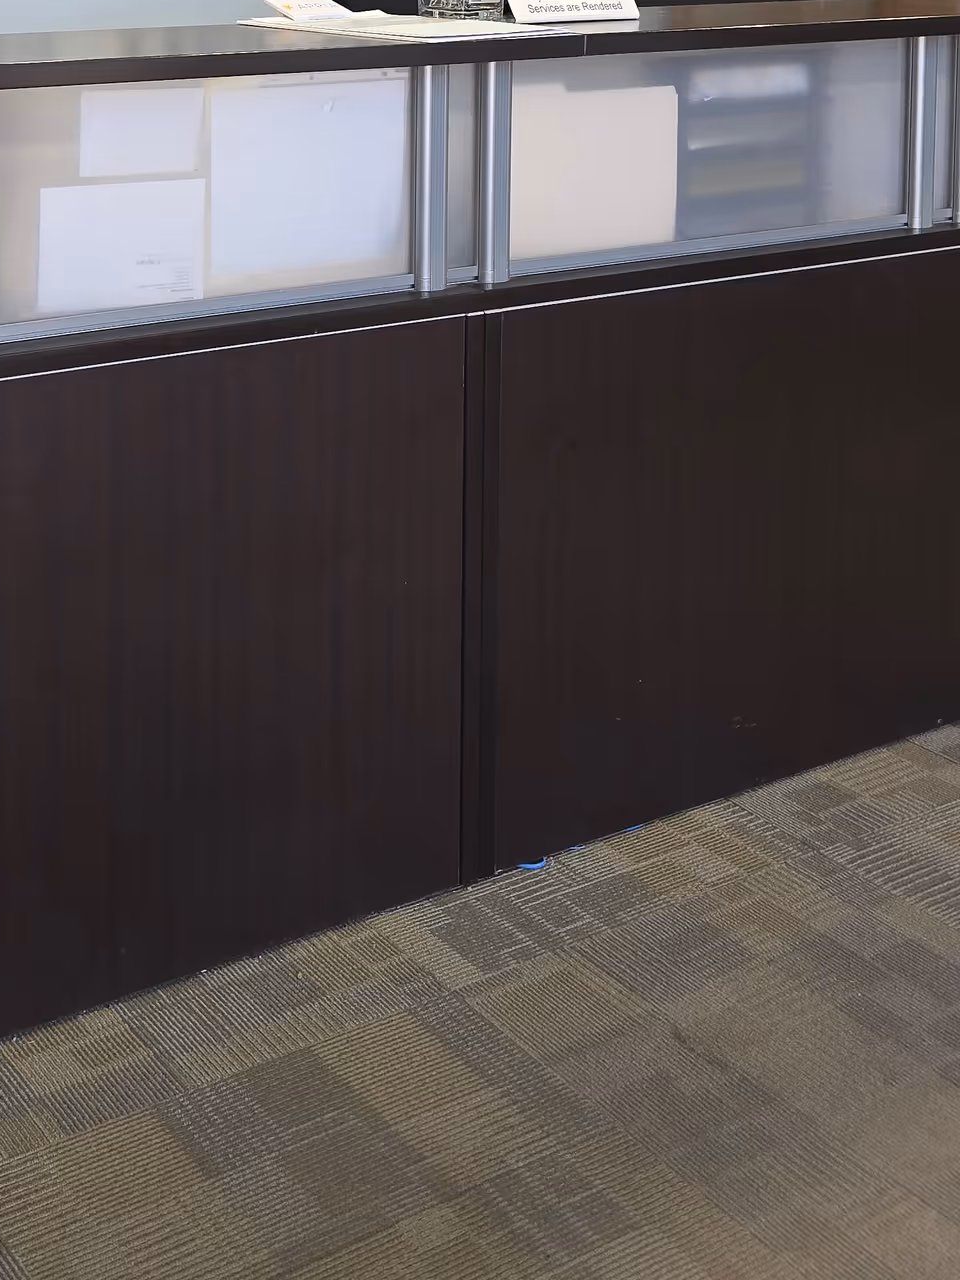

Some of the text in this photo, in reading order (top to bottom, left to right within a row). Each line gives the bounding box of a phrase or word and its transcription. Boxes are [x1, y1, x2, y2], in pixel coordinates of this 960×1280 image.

[527, 1, 623, 13] Services are Rendered
